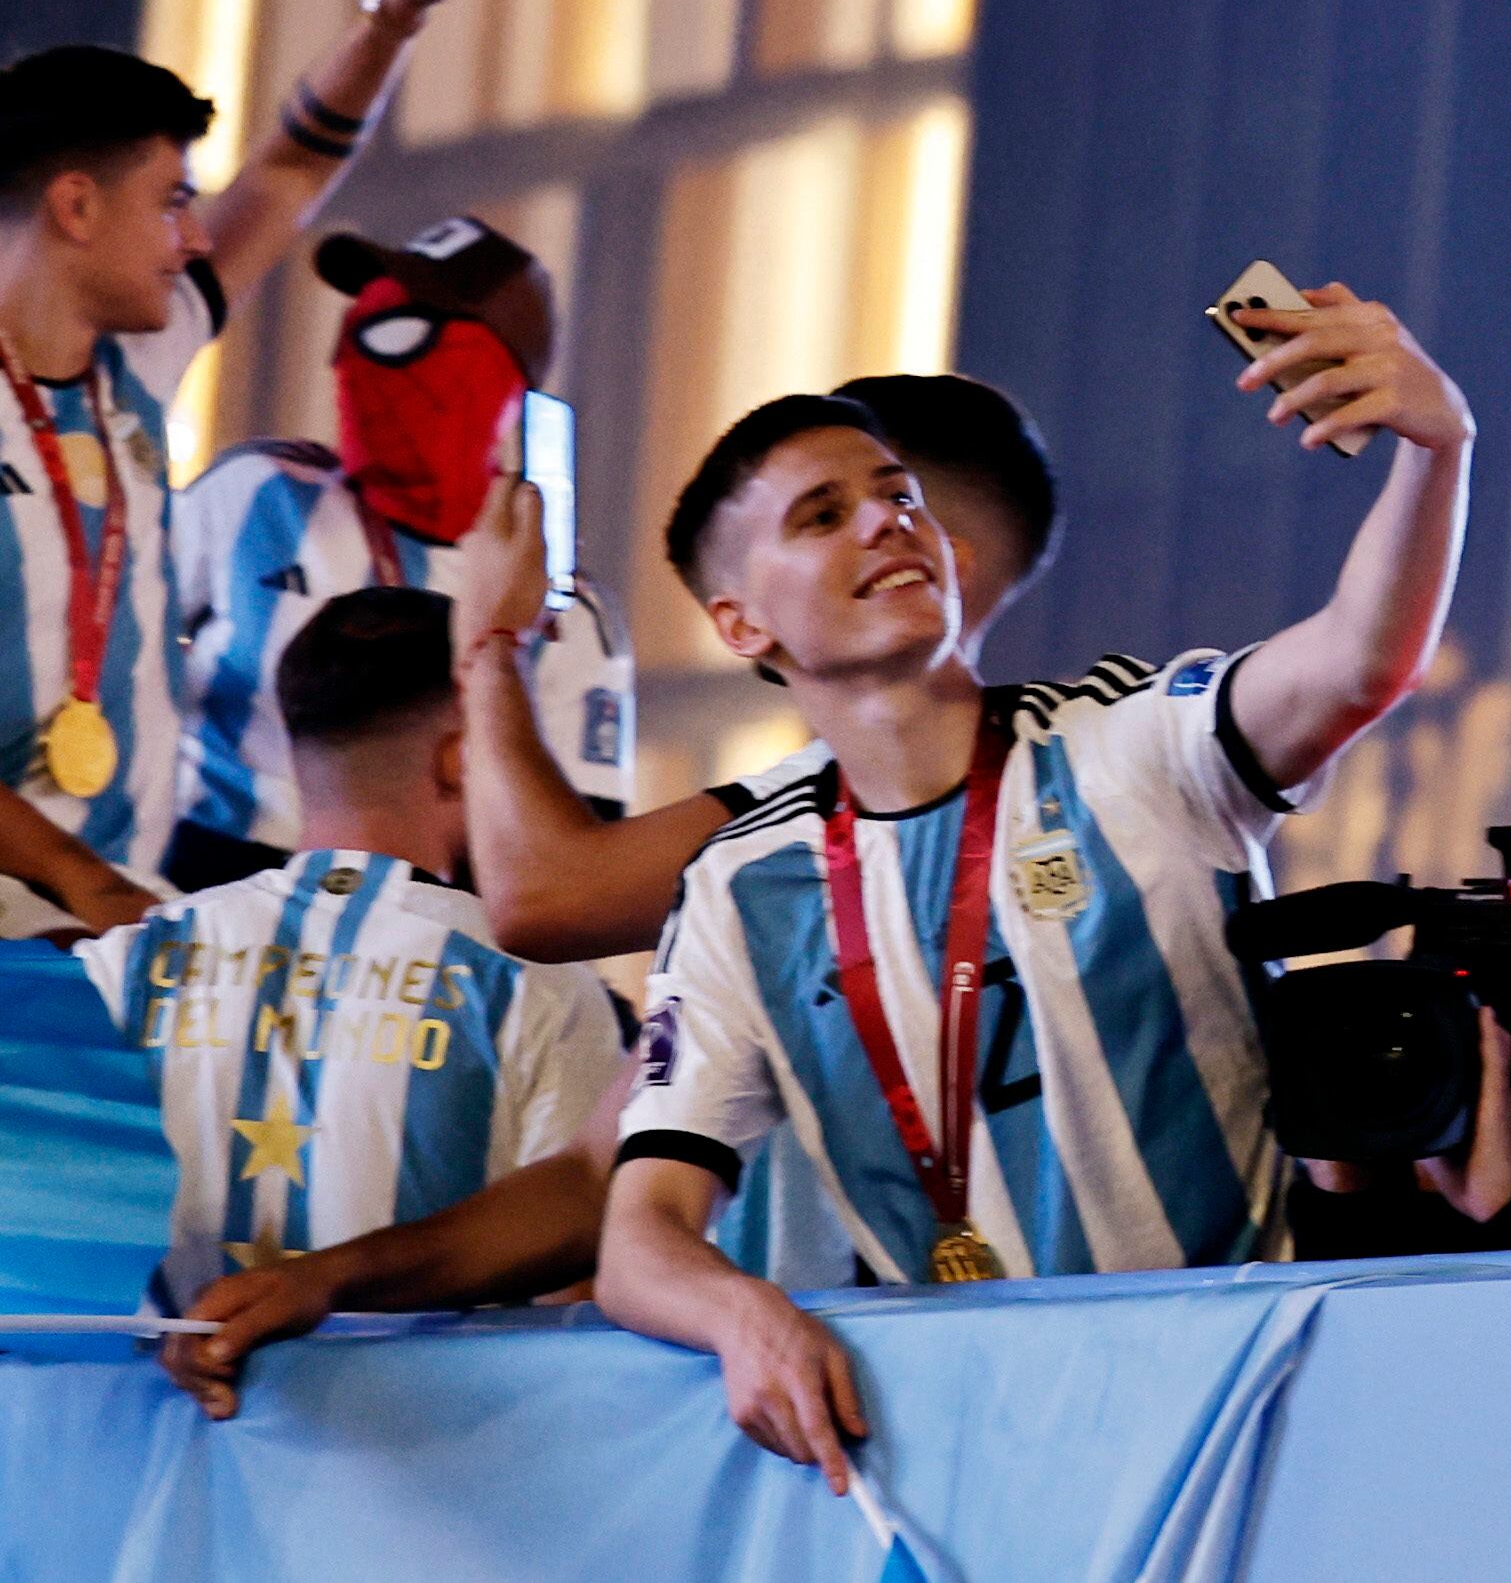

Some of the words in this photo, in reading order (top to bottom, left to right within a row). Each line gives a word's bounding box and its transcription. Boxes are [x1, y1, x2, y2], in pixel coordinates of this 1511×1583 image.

[150, 941, 473, 1009] CAMPEONES
[143, 995, 230, 1048] DEL
[254, 1003, 451, 1071] MUNDO
